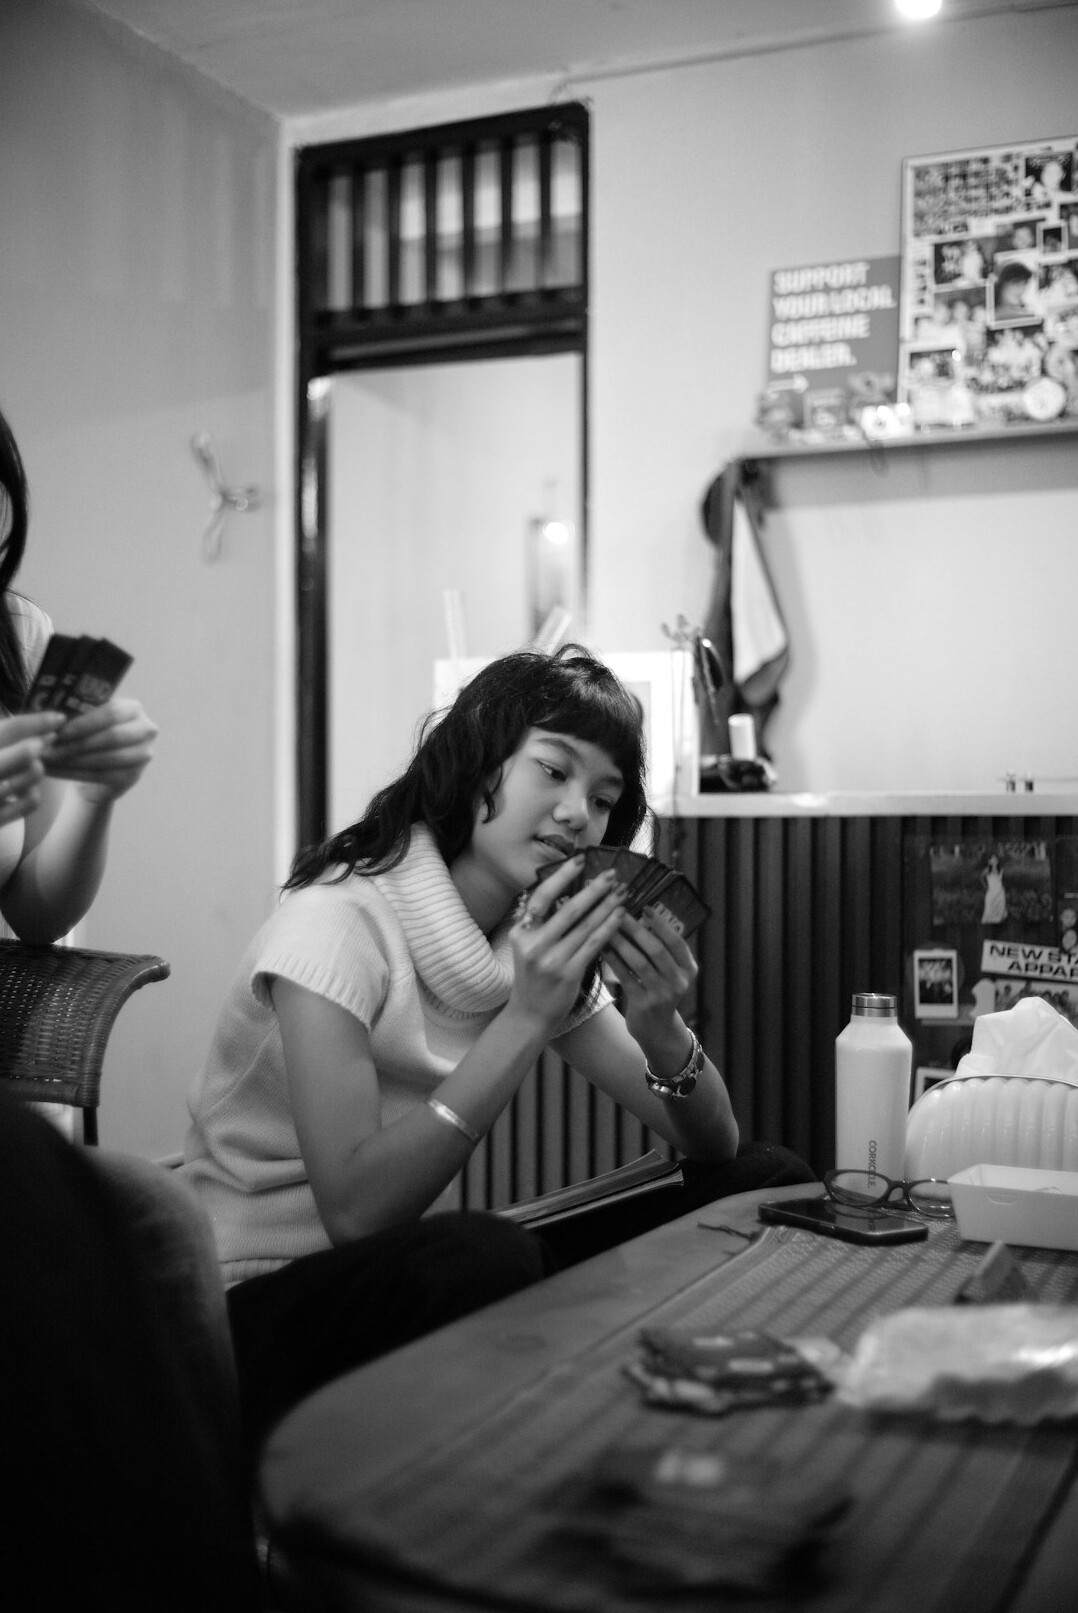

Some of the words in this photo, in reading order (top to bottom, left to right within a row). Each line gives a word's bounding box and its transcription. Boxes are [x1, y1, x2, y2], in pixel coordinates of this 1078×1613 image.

[773, 262, 871, 295] SUPPORT
[772, 292, 829, 320] YOUR
[829, 284, 897, 315] LOCAL
[990, 944, 1043, 960] NEW
[868, 1140, 877, 1189] CORKCLE.
